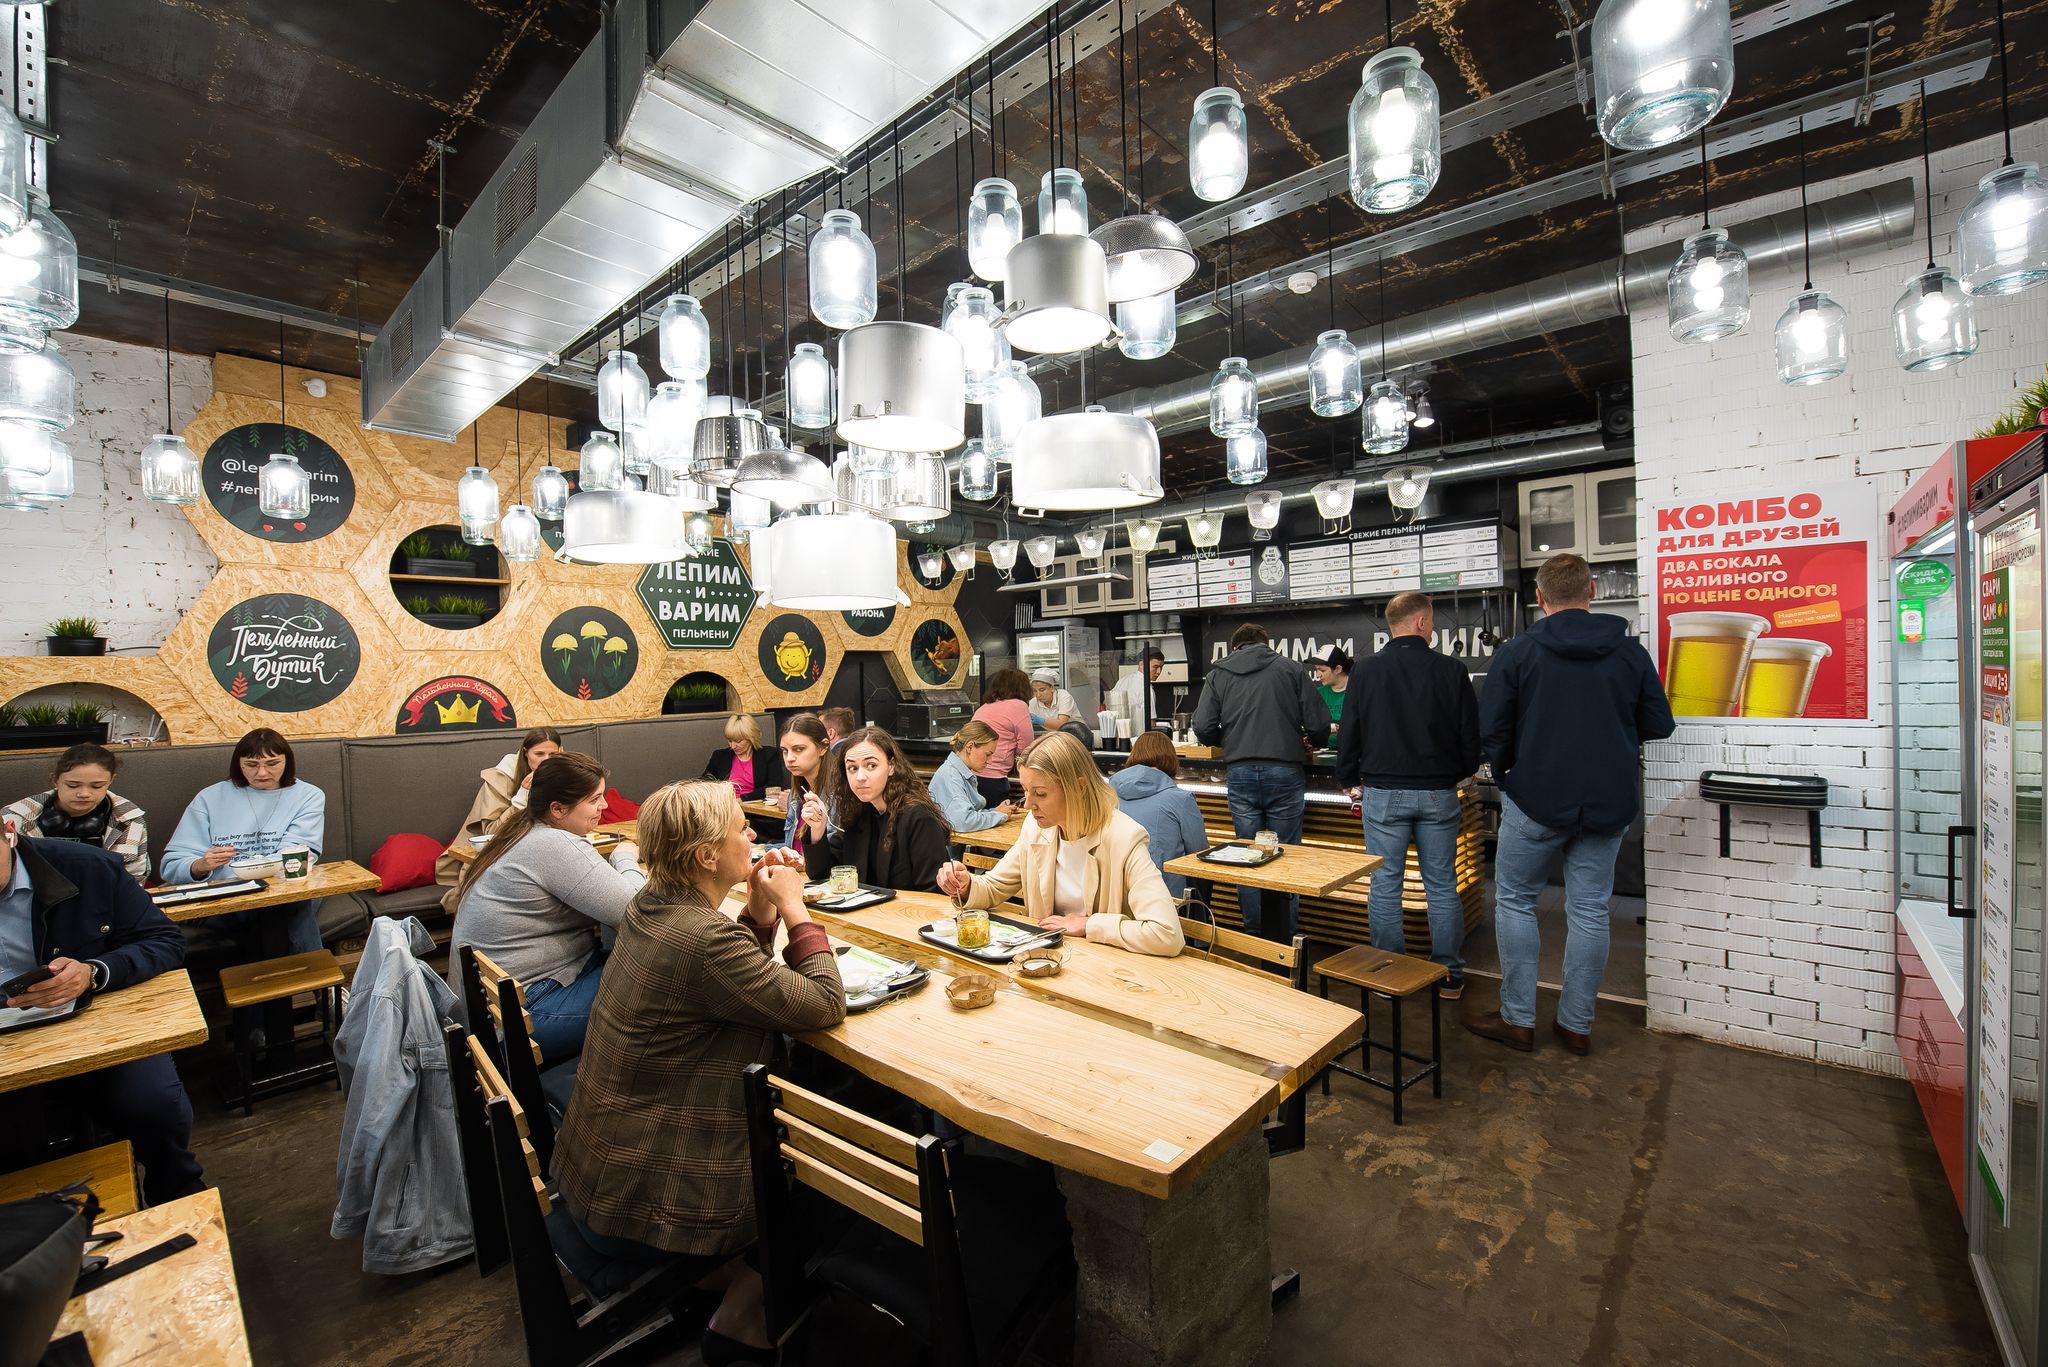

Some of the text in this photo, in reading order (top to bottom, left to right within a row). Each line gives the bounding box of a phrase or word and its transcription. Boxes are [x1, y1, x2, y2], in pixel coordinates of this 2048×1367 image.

[1657, 492, 1822, 532] КОМБО
[1349, 525, 1426, 541] СВЕЖИЕ ПЕЛЬМЕНИ
[1657, 517, 1840, 553] ДЛЯ ДРУЗЕЙ
[656, 562, 742, 586] ЛЕПИМ
[1662, 554, 1782, 575] ДВА БОКАЛА
[1904, 568, 1944, 578] СКИДКА
[1663, 570, 1788, 590] РАЗЛИВНОГО
[1982, 577, 2001, 597] СВАРИ
[695, 586, 706, 599] И
[1663, 583, 1838, 605] ПО ЦЕНЕ ОДНОГО!
[658, 600, 741, 624] ВАРИМ
[226, 615, 347, 667] Пельменный
[673, 628, 729, 639] ПЕЛЬМЕНИ
[242, 650, 344, 689] Бутик
[413, 681, 500, 704] Пельменный Король
